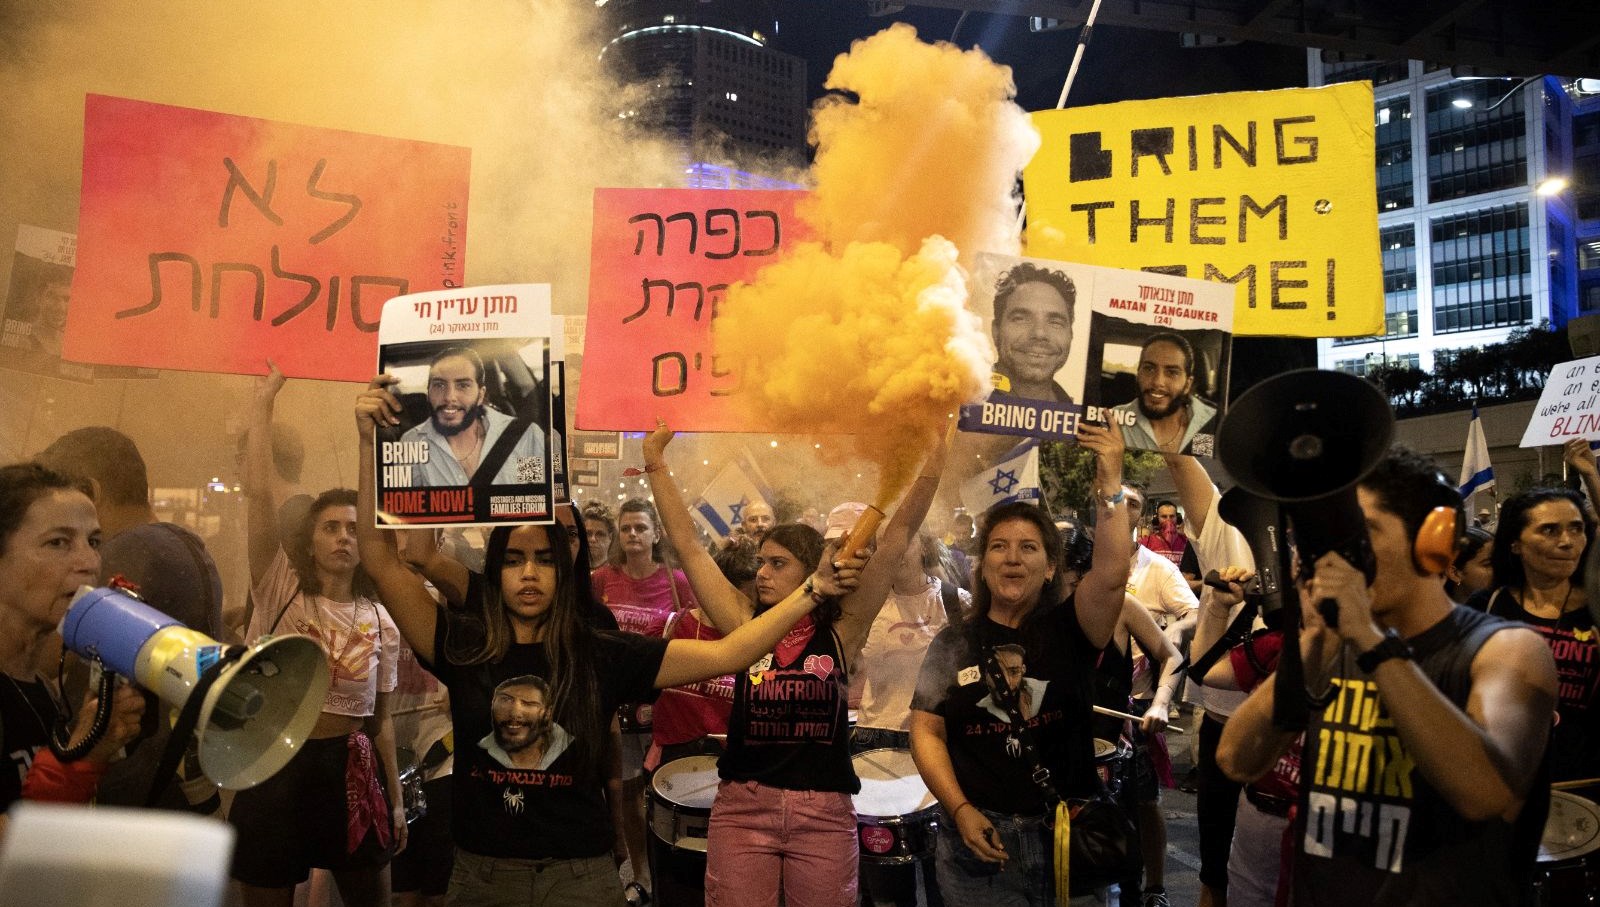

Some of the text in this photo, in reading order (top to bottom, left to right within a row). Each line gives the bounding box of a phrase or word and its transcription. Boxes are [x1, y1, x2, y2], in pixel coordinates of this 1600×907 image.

[1070, 115, 1319, 183] BRING
[218, 157, 363, 244] לא
[1070, 194, 1288, 245] THEM
[628, 208, 781, 259] כפרה
[115, 244, 409, 333] סולחת
[1120, 257, 1337, 321] ME!
[414, 295, 518, 321] מתן עדיין חי
[1109, 298, 1218, 322] MATAN ZANGAUKER
[1153, 315, 1173, 326] (24)
[429, 322, 446, 335] (24)
[981, 401, 1037, 431] BRING
[1086, 405, 1137, 426] BRNG
[1549, 413, 1600, 438] BLIN
[382, 441, 429, 464] BRING
[383, 465, 412, 488] HIM
[383, 486, 474, 514] HOME NOW!
[490, 502, 547, 515] FAMILIES FORUM
[750, 679, 834, 701] PINKFRONT
[1303, 791, 1411, 874] חיים
